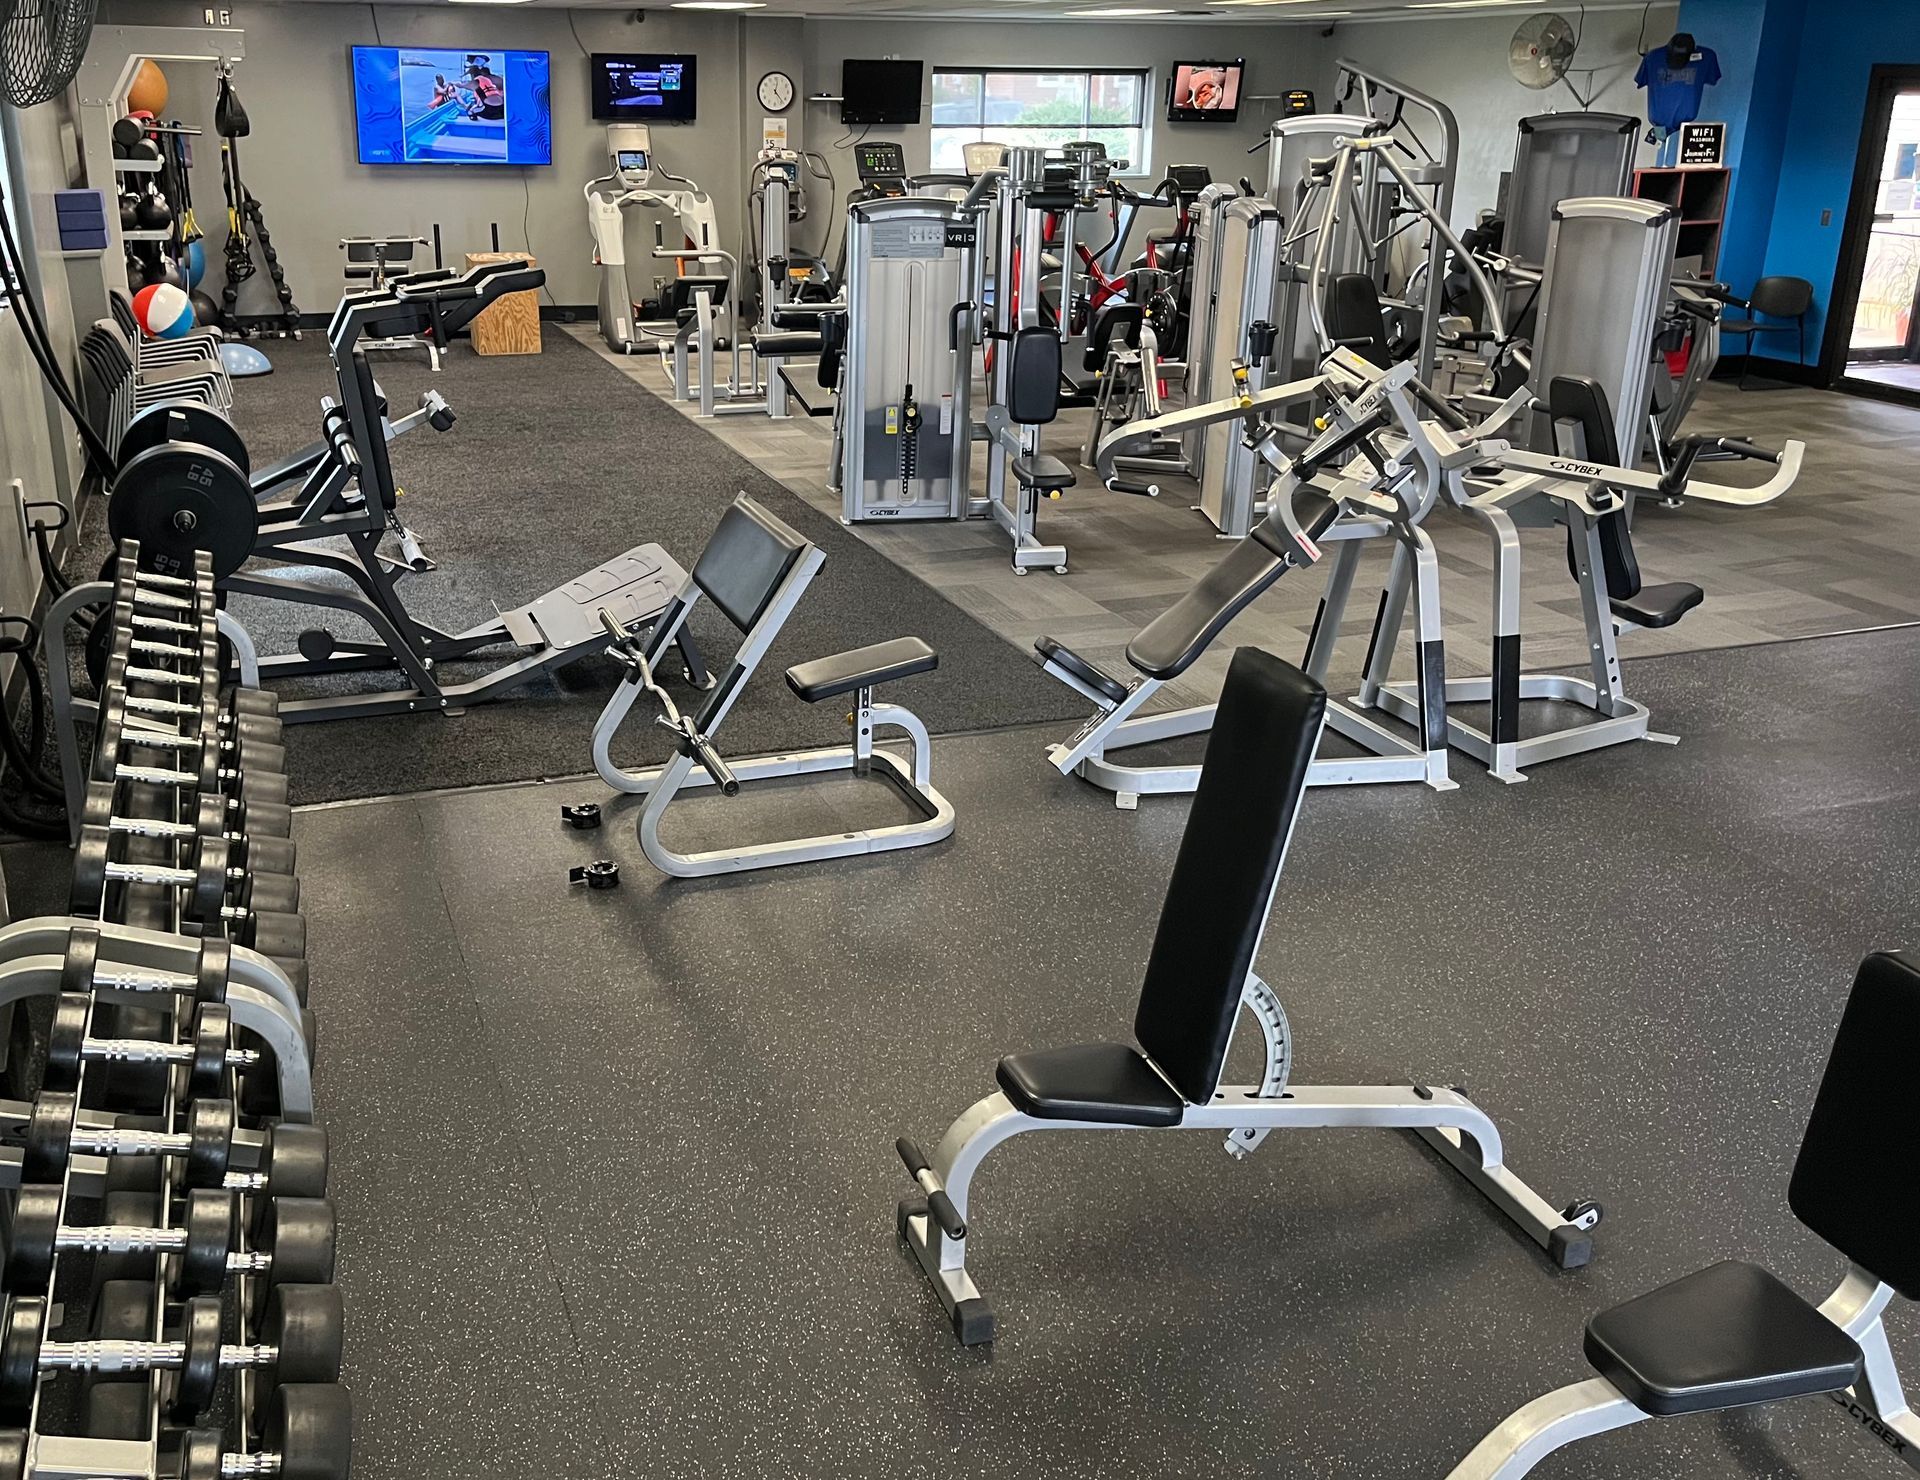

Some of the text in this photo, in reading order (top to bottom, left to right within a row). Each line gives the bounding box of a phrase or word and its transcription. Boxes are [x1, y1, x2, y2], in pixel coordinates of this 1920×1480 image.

[1692, 128, 1713, 137] WIFI
[187, 463, 202, 481] LB
[199, 467, 215, 487] 45
[1565, 463, 1603, 476] CYBEX
[153, 553, 168, 572] 45
[1848, 1402, 1907, 1454] CYBEX
